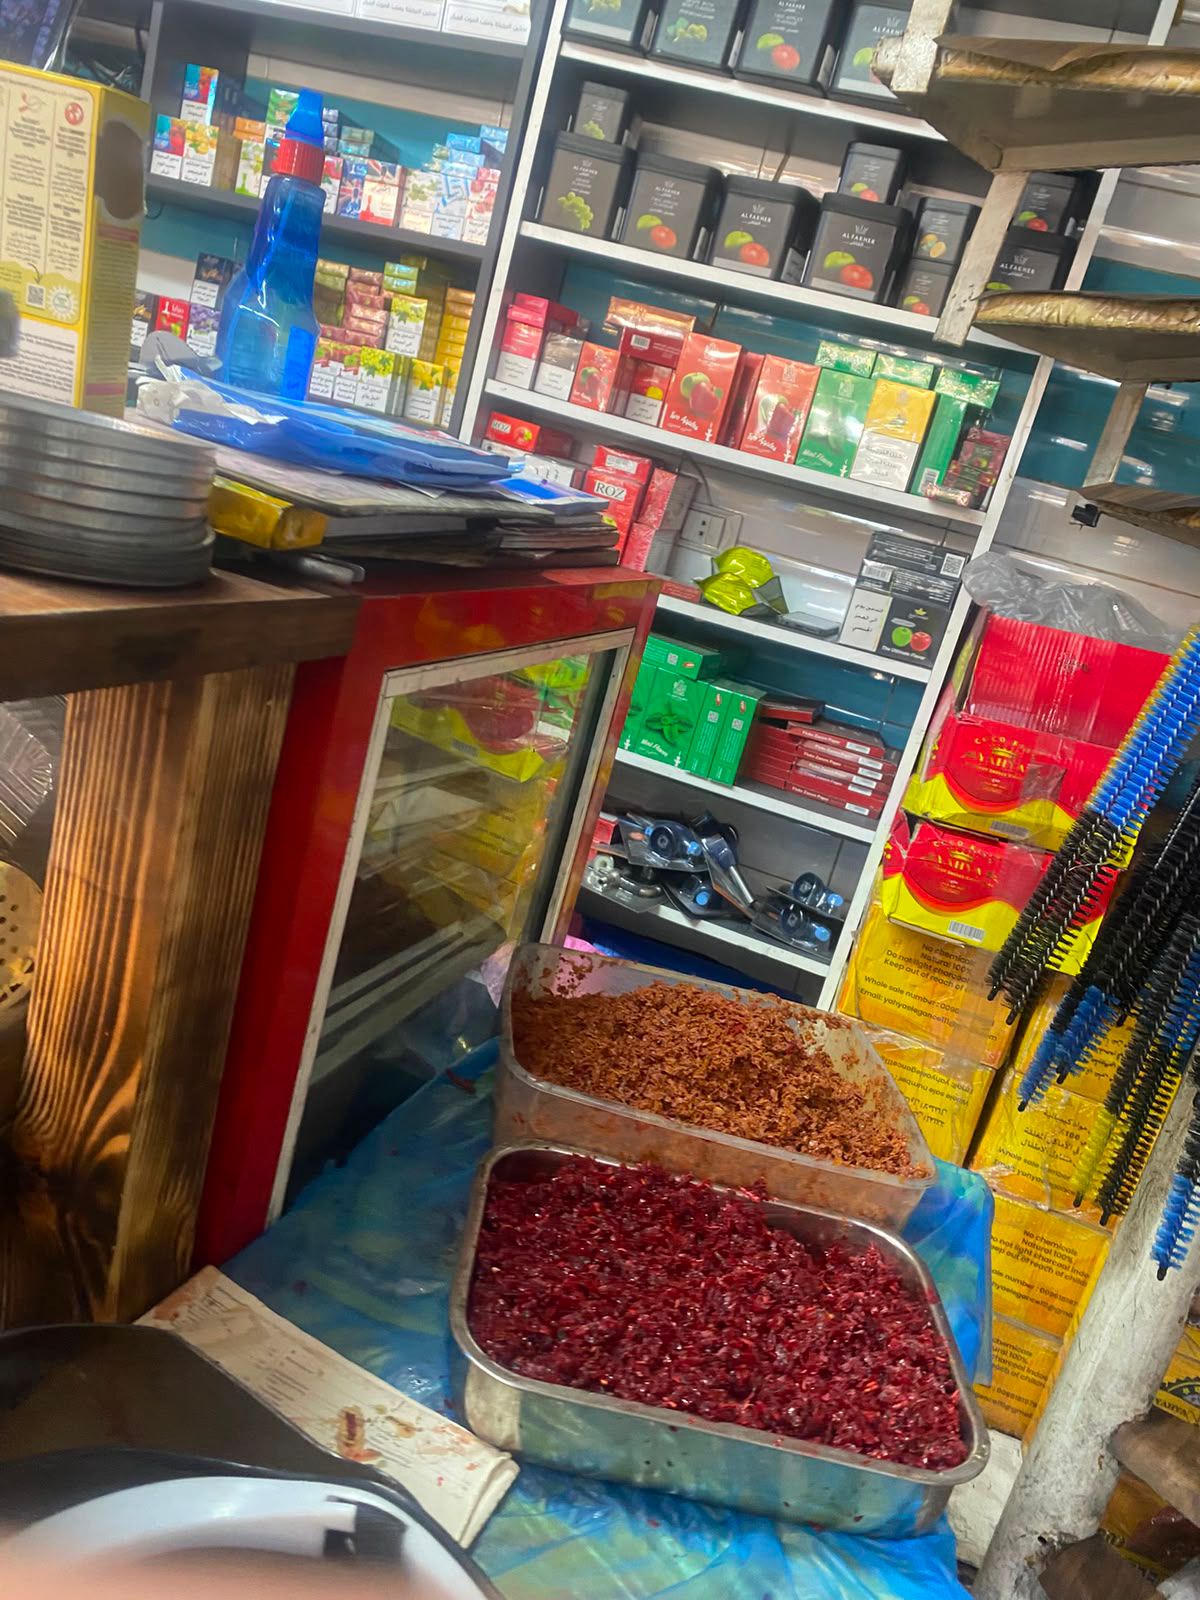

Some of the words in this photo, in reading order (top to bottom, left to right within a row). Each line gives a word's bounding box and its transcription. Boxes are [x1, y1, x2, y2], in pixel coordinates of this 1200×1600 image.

[596, 483, 625, 499] ROZ
[923, 943, 933, 952] No
[887, 949, 896, 958] Do
[898, 953, 912, 963] not
[913, 956, 932, 973] light
[884, 958, 904, 971] Keep
[905, 966, 919, 976] out
[921, 970, 930, 978] of
[930, 973, 955, 988] reach
[864, 975, 887, 989] Whole
[889, 983, 904, 995] sale
[860, 988, 883, 1002] Email:
[898, 1076, 928, 1092] number
[929, 1087, 944, 1097] sale
[1021, 1238, 1053, 1254] Natural
[1023, 1230, 1034, 1239] No
[1035, 1235, 1078, 1256] chemicals
[1000, 1239, 1014, 1248] not
[1015, 1243, 1033, 1258] light
[1034, 1251, 1071, 1272] charcoal
[1006, 1251, 1020, 1261] out
[1021, 1255, 1030, 1263] of
[1030, 1260, 1054, 1274] reach
[1055, 1268, 1065, 1277] of
